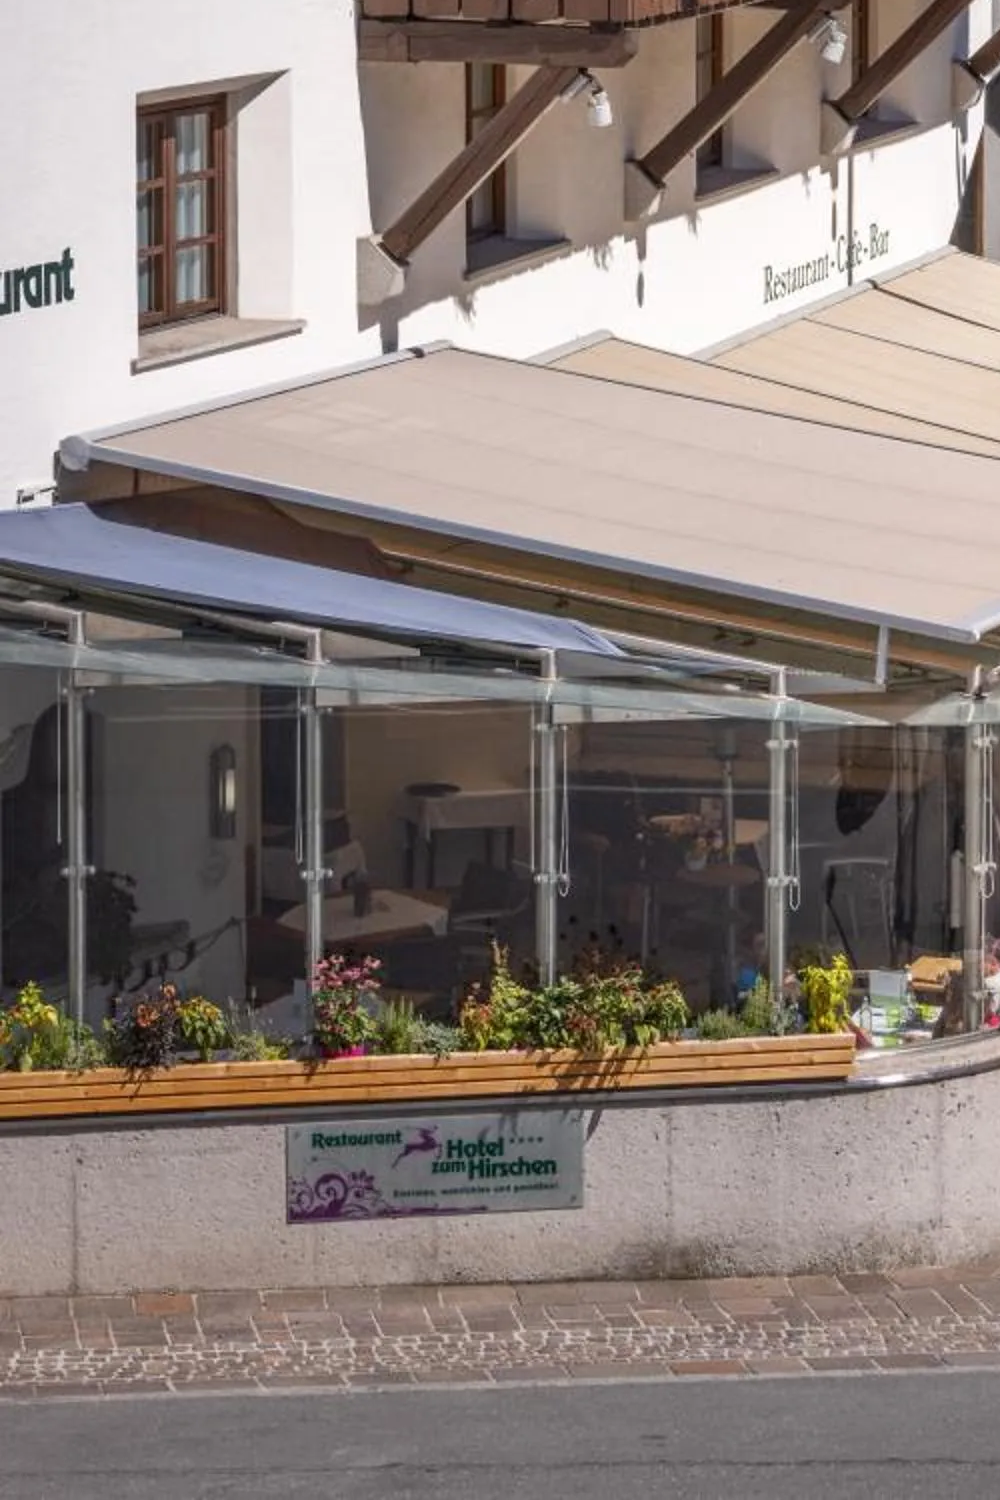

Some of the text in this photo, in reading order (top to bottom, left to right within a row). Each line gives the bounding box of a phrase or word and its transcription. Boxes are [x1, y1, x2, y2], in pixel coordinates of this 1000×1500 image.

[763, 253, 829, 304] Restaurant
[311, 1130, 402, 1149] Restaurant
[446, 1137, 504, 1159] Hotel
[431, 1156, 558, 1181] zum Hirschen
